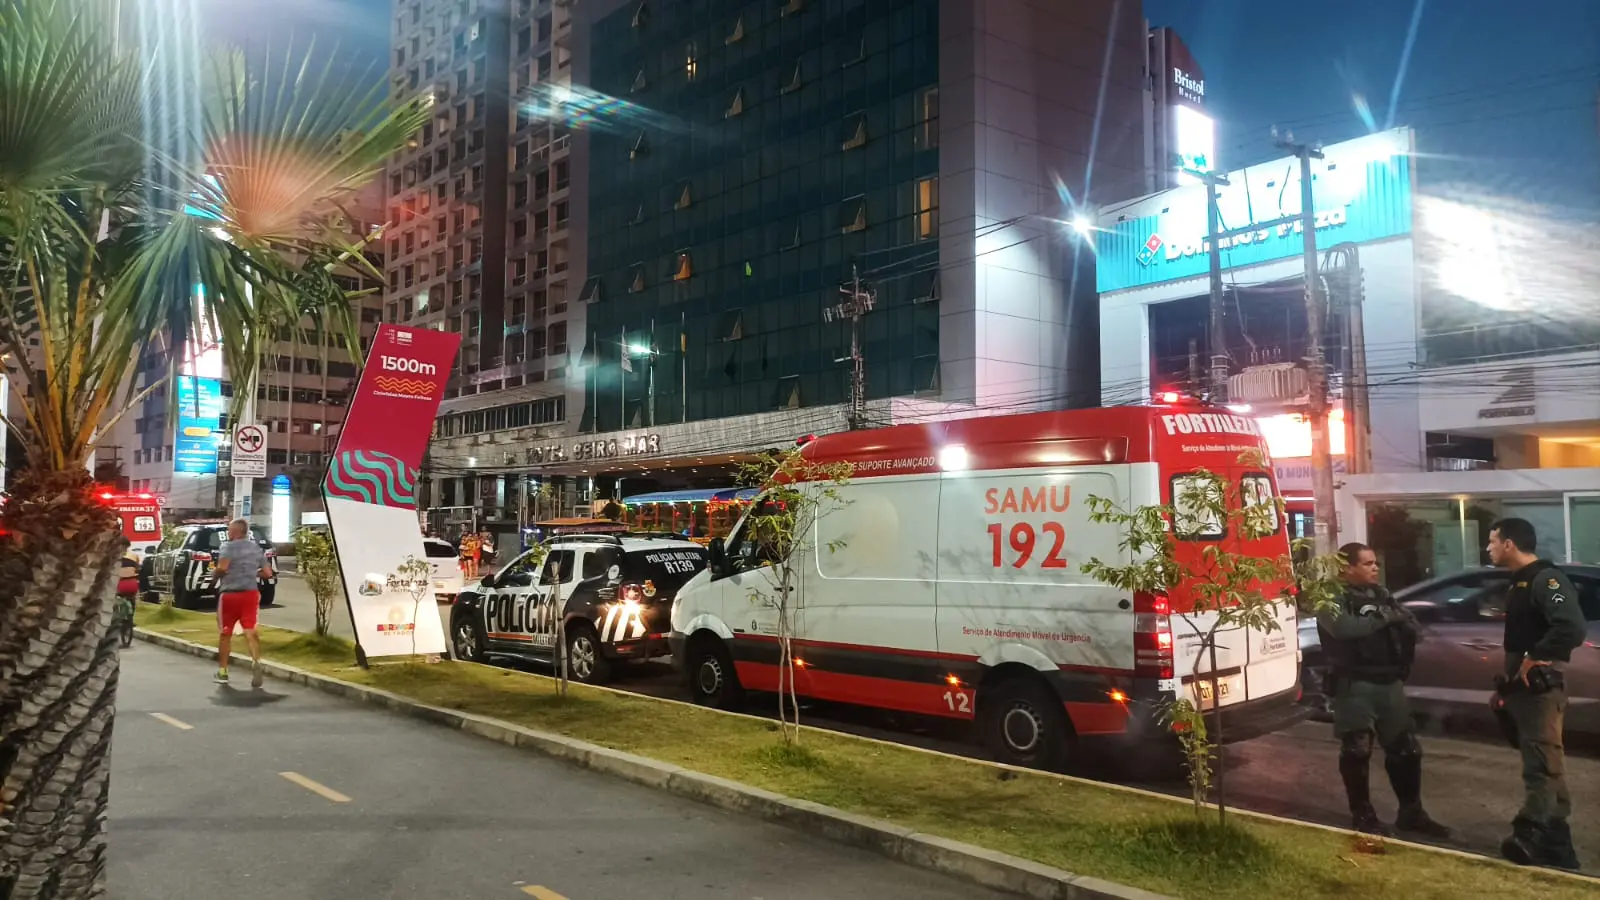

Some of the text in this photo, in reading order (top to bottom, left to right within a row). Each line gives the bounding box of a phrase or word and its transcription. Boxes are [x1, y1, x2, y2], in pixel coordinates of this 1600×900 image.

[1174, 67, 1204, 96] Bristol
[380, 355, 436, 375] 1500m
[858, 459, 893, 470] SUPORTE
[893, 456, 935, 470] AVANÇADO
[984, 484, 1071, 514] SAMU
[986, 521, 1068, 569] 192
[673, 551, 702, 561] MILITAR
[664, 560, 695, 574] R139
[962, 626, 985, 637] Serviço
[985, 628, 993, 636] de
[993, 629, 1031, 640] Atendimento
[1052, 632, 1060, 641] de
[943, 691, 972, 713] 12
